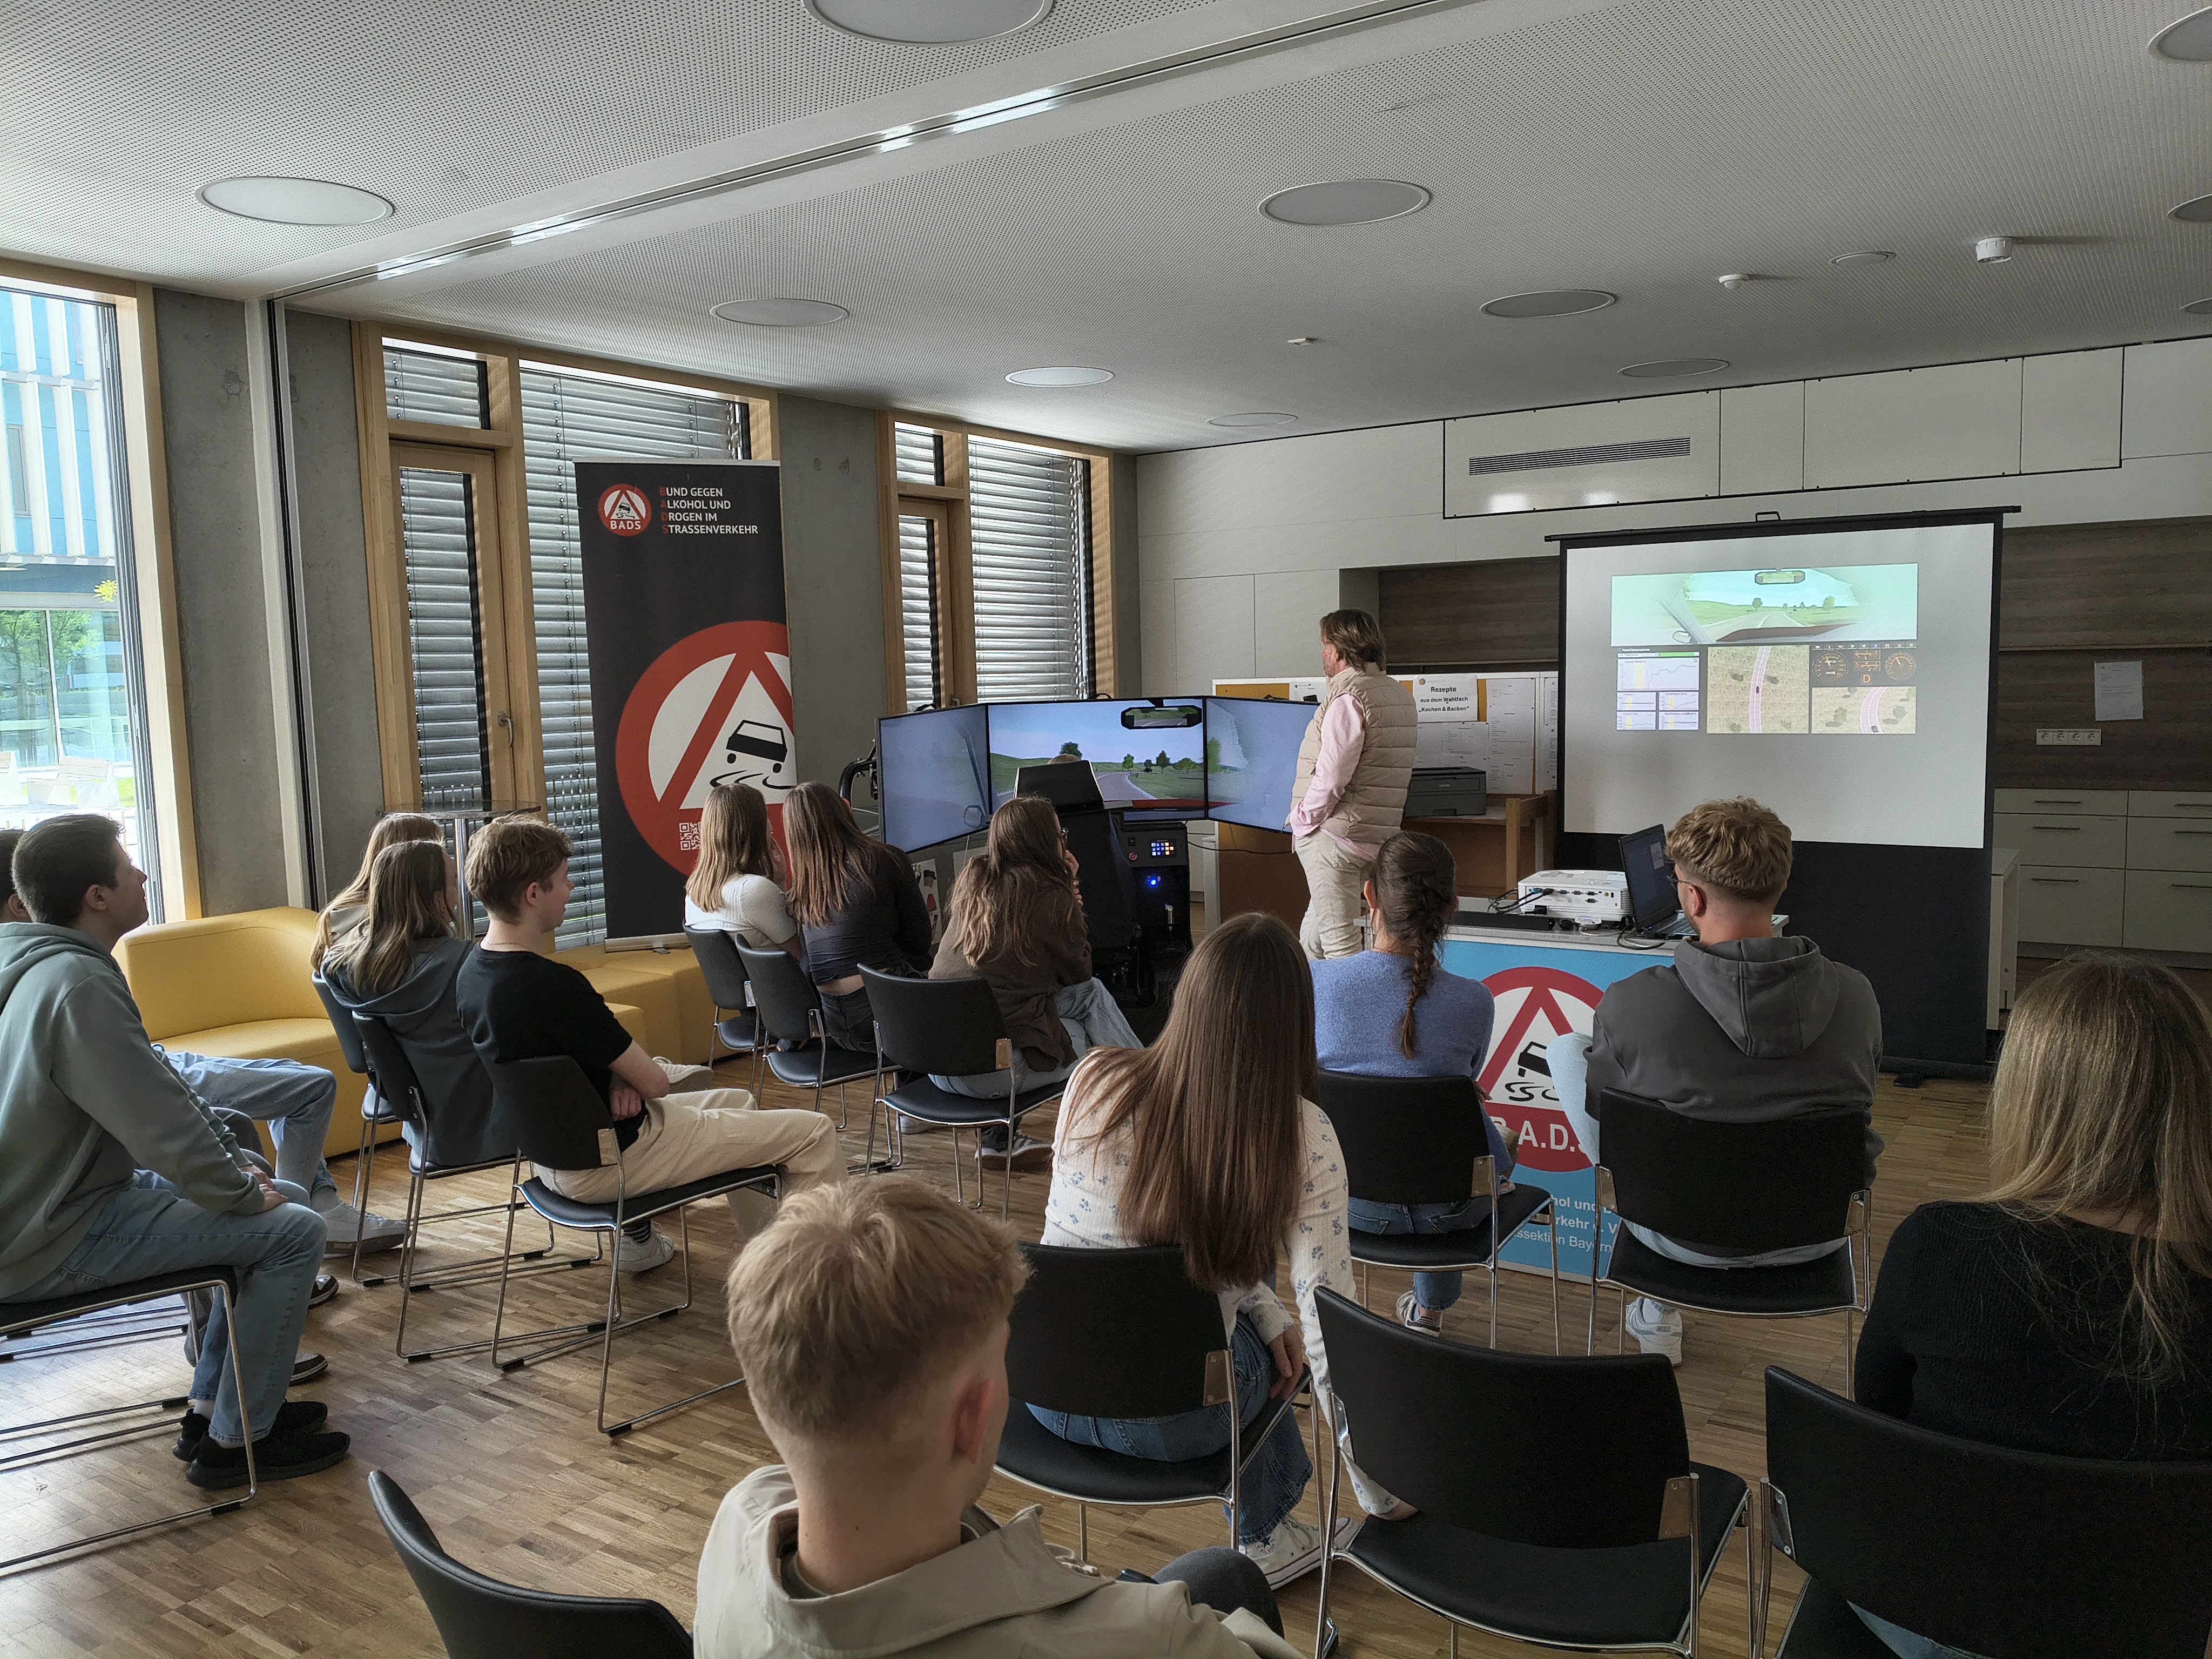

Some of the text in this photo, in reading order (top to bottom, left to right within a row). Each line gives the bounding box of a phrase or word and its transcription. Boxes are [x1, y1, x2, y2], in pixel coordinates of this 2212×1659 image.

[659, 487, 723, 497] BUND GEGEN
[660, 500, 731, 509] ALKOHOL UND
[660, 511, 717, 522] DROGEN IM
[610, 520, 641, 530] BADS
[662, 524, 758, 534] STRASSENVERKEHR
[1569, 1236, 1612, 1252] Bayrn
